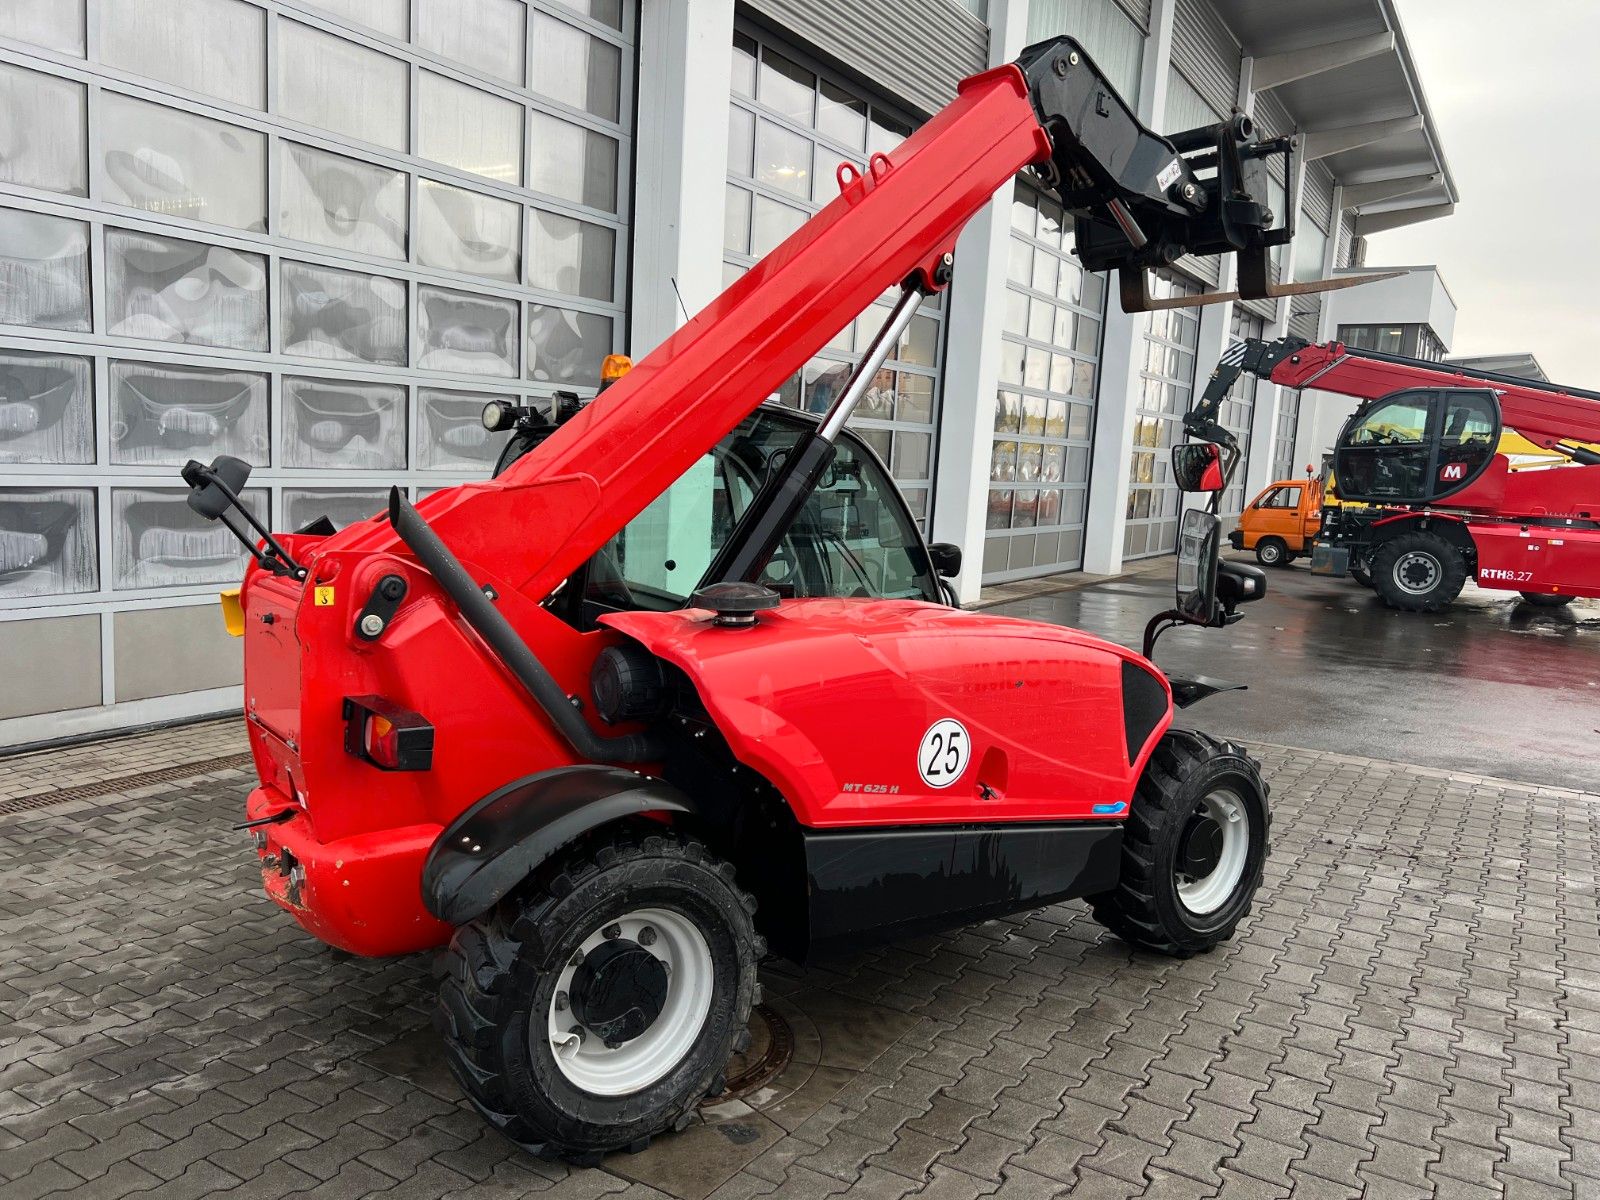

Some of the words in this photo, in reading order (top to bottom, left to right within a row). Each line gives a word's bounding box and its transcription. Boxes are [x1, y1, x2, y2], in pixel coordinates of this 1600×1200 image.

[1444, 465, 1461, 479] M
[1480, 568, 1534, 582] RTH8.27
[926, 732, 961, 776] 25
[842, 783, 863, 792] MT
[863, 784, 887, 793] 625
[889, 785, 900, 794] H
